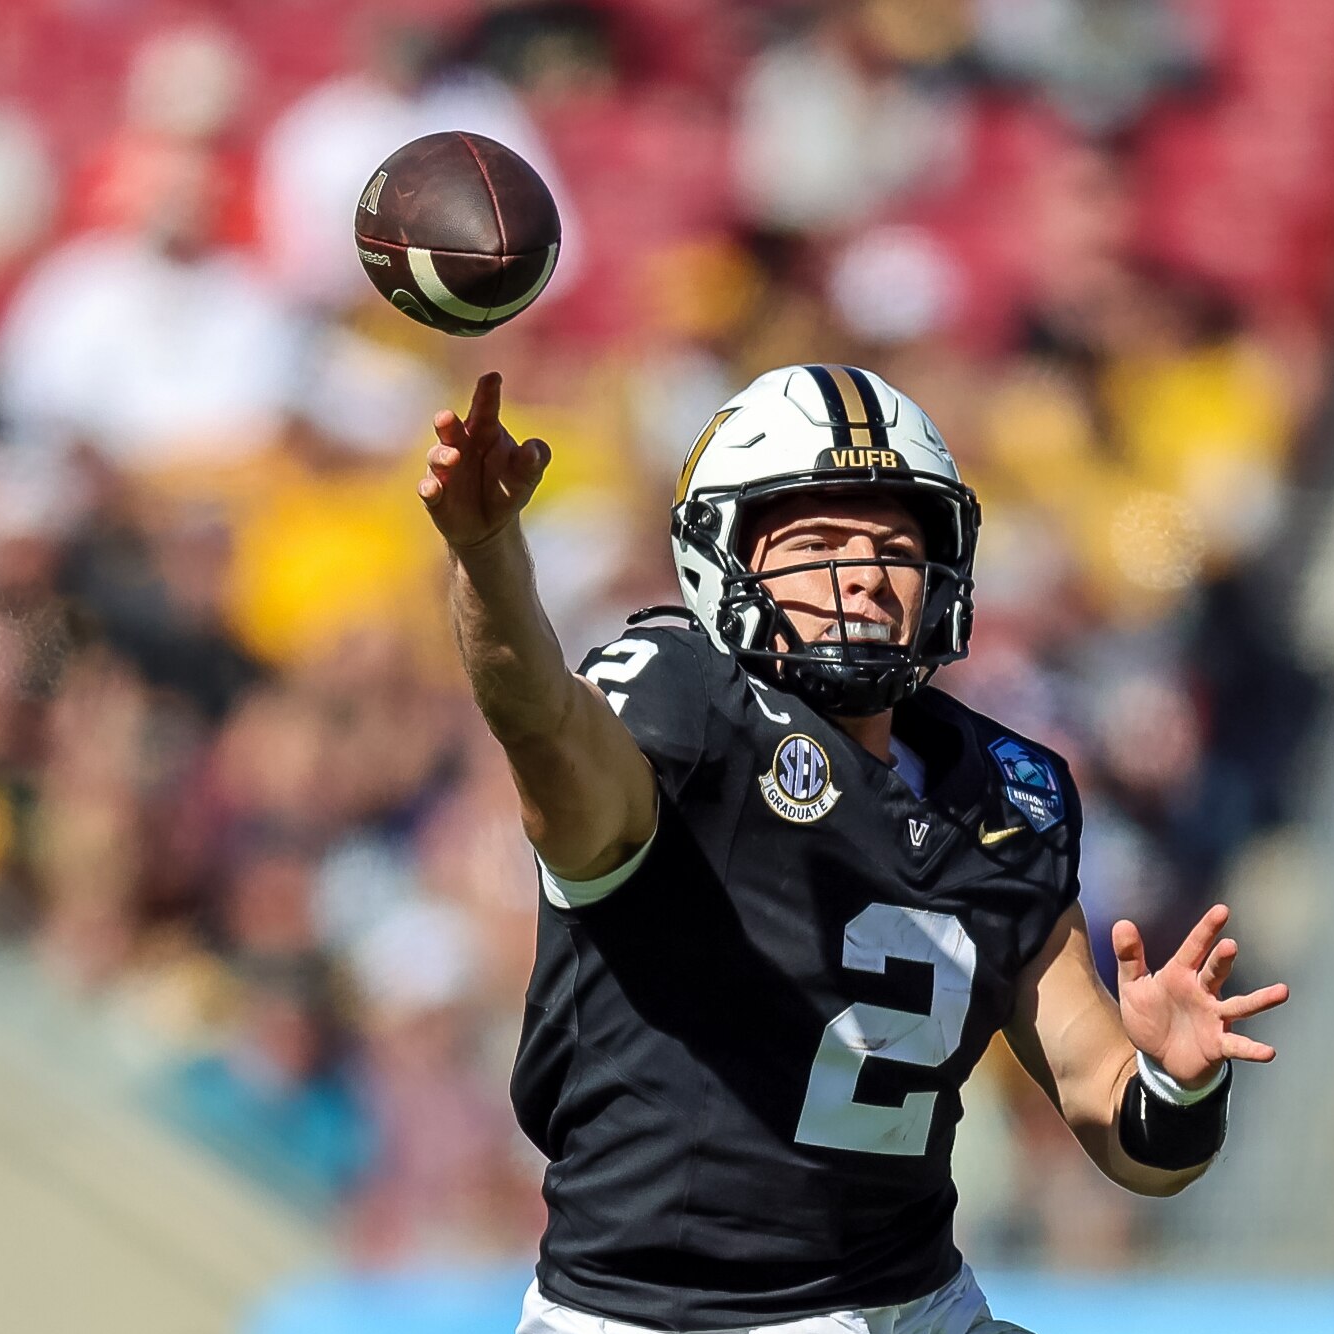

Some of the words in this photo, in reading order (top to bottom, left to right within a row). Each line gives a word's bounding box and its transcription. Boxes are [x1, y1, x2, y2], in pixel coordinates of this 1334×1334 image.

[830, 450, 897, 468] VUFB
[585, 638, 659, 717] 2
[779, 739, 824, 799] SEC
[767, 789, 829, 820] GRADUATE
[908, 818, 930, 847] V
[794, 902, 977, 1156] 2
